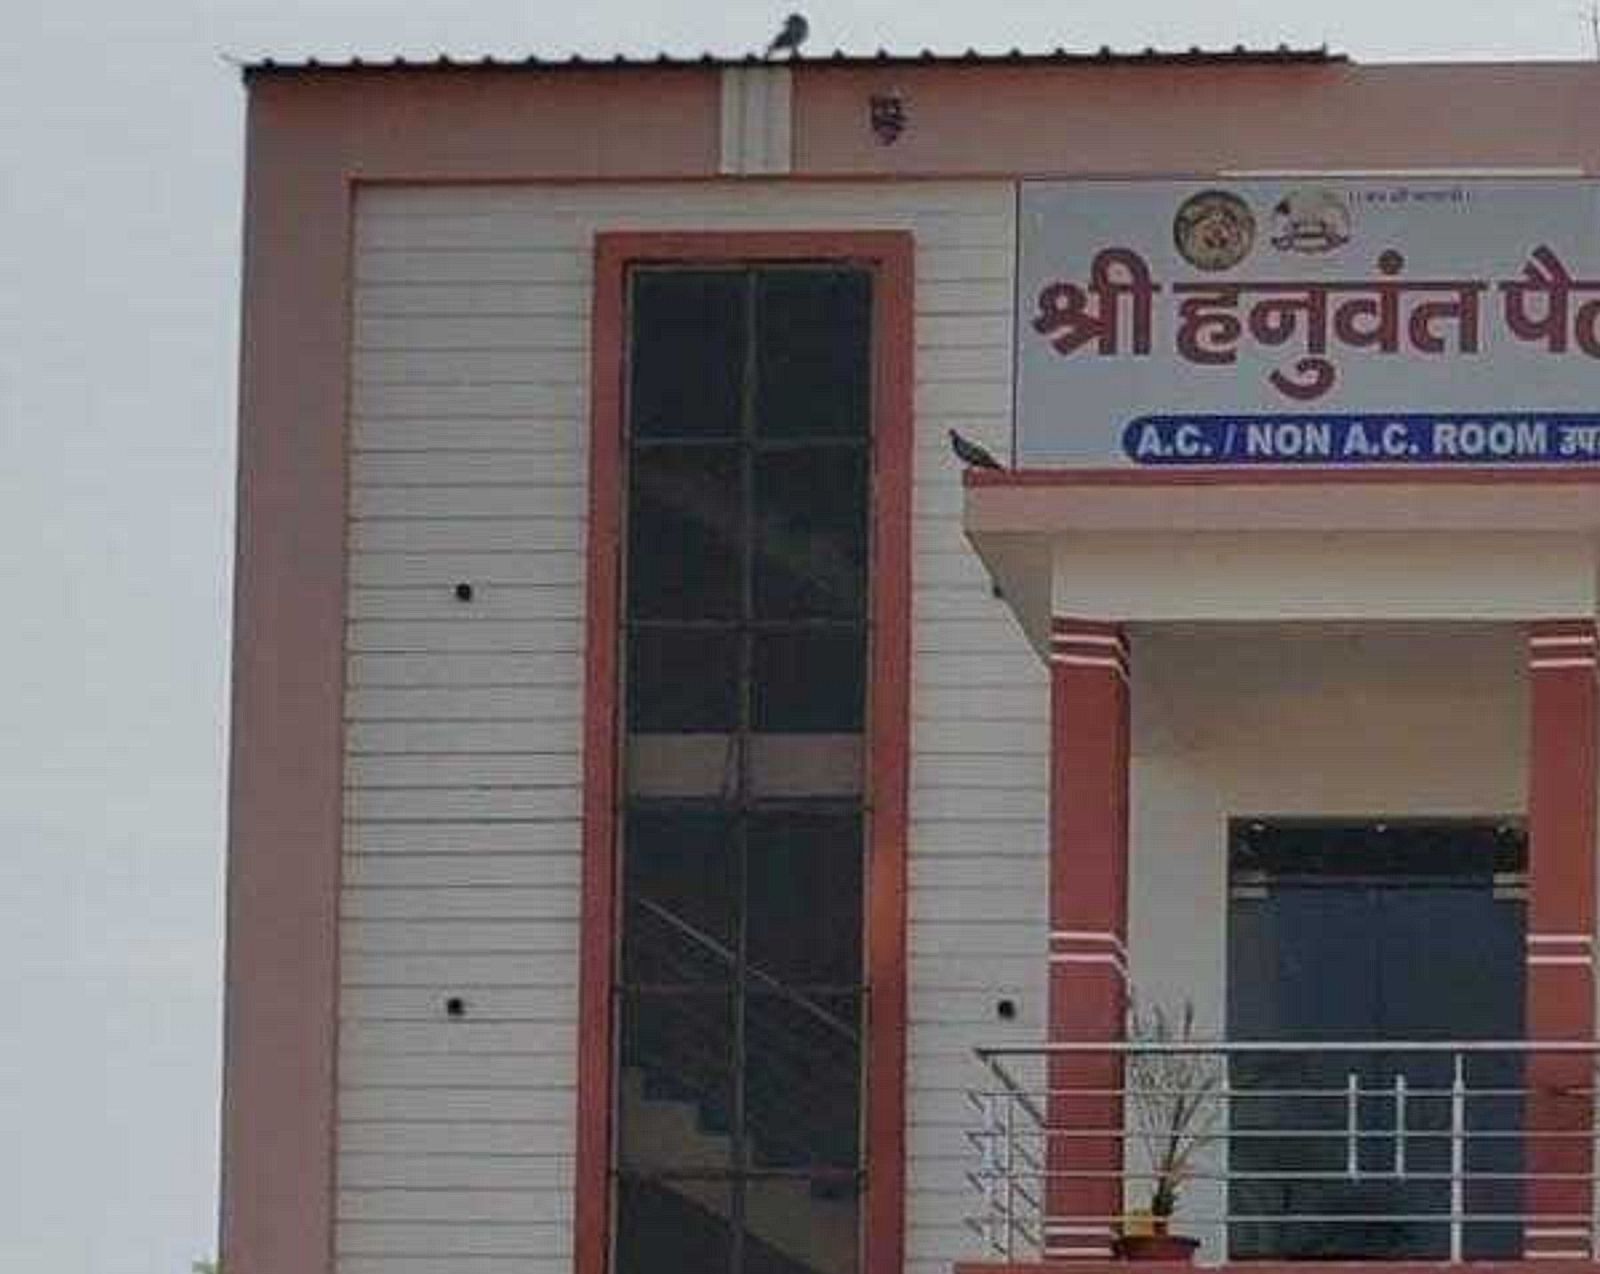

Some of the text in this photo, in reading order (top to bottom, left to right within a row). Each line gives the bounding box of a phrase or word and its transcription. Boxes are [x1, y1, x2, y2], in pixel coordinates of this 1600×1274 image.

[1032, 246, 1161, 357] श्री
[1172, 249, 1487, 400] हनुवंत
[1137, 424, 1213, 456] A.C.
[1247, 422, 1331, 455] NON
[1343, 421, 1420, 455] A.C.
[1432, 421, 1549, 455] ROOM
